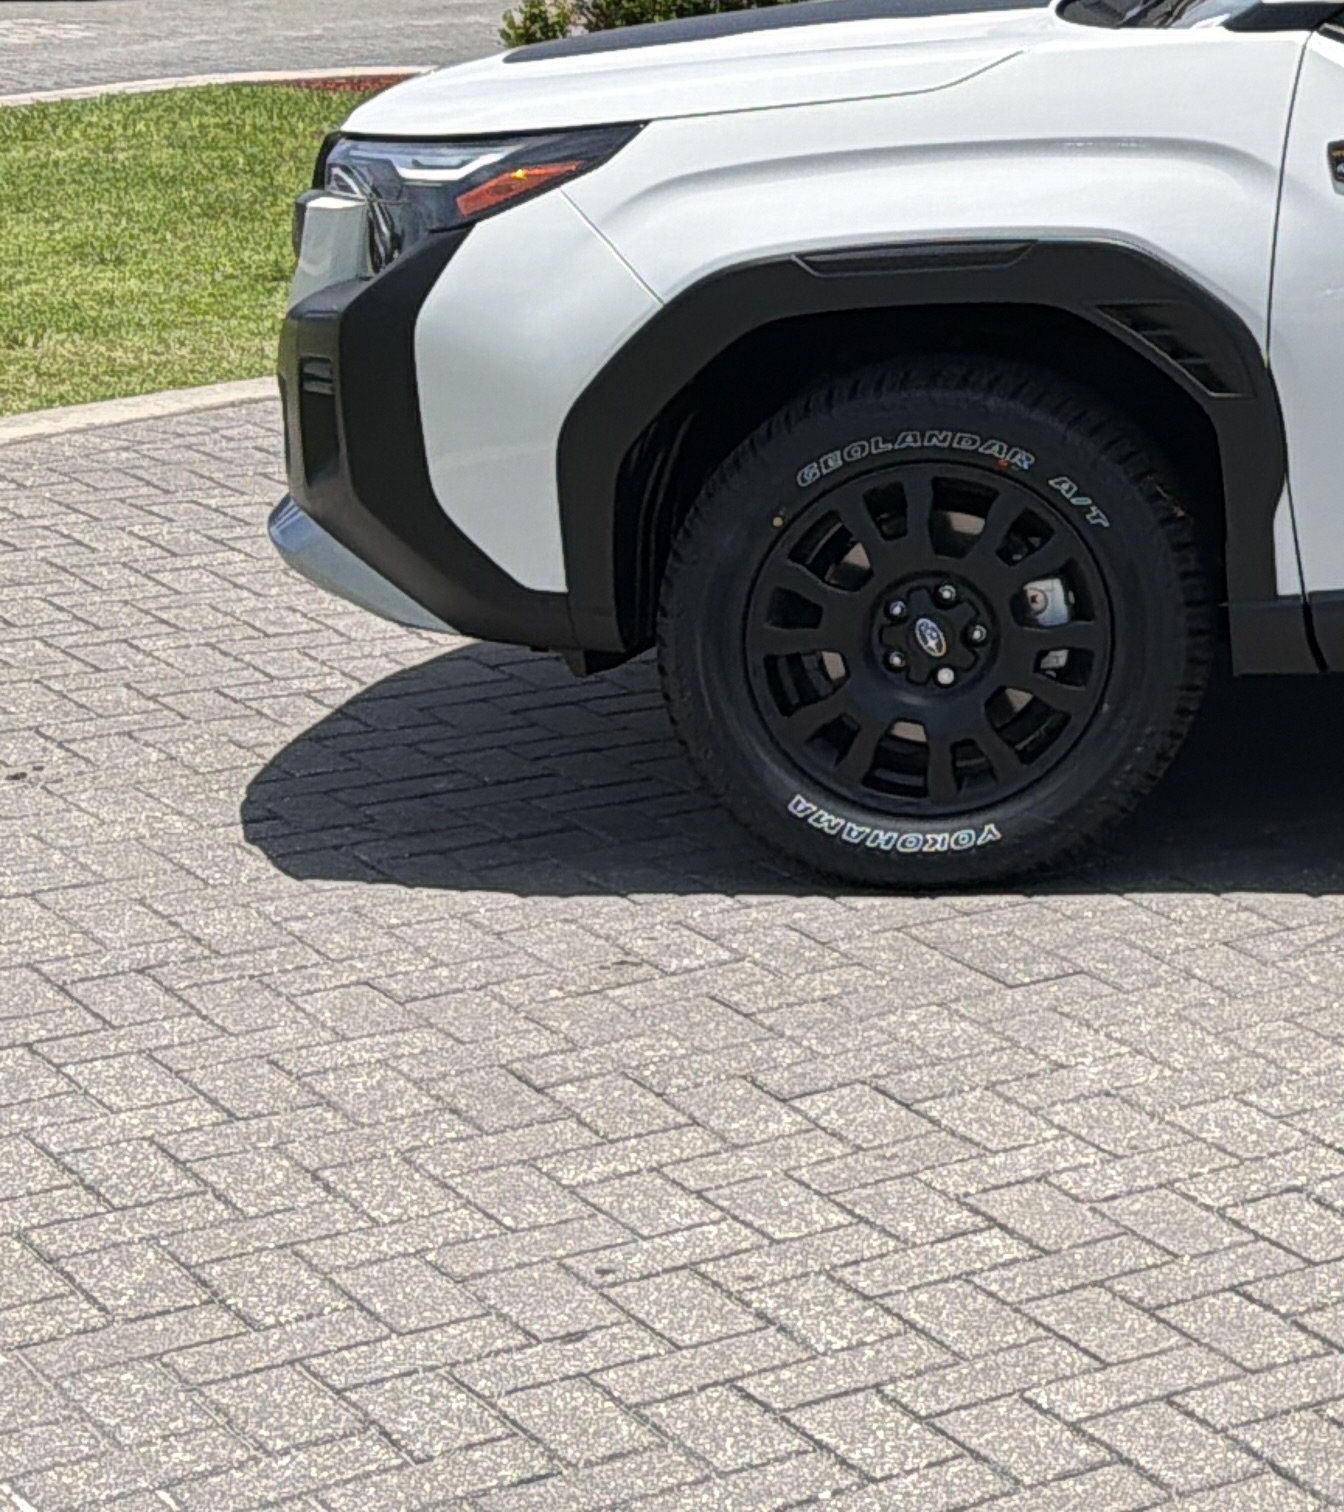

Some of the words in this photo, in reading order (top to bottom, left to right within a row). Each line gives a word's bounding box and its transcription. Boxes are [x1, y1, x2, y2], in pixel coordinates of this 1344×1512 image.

[796, 430, 1036, 488] GEOLANDAR
[1049, 474, 1110, 529] A/T
[787, 793, 1002, 854] YOKOHAMA
